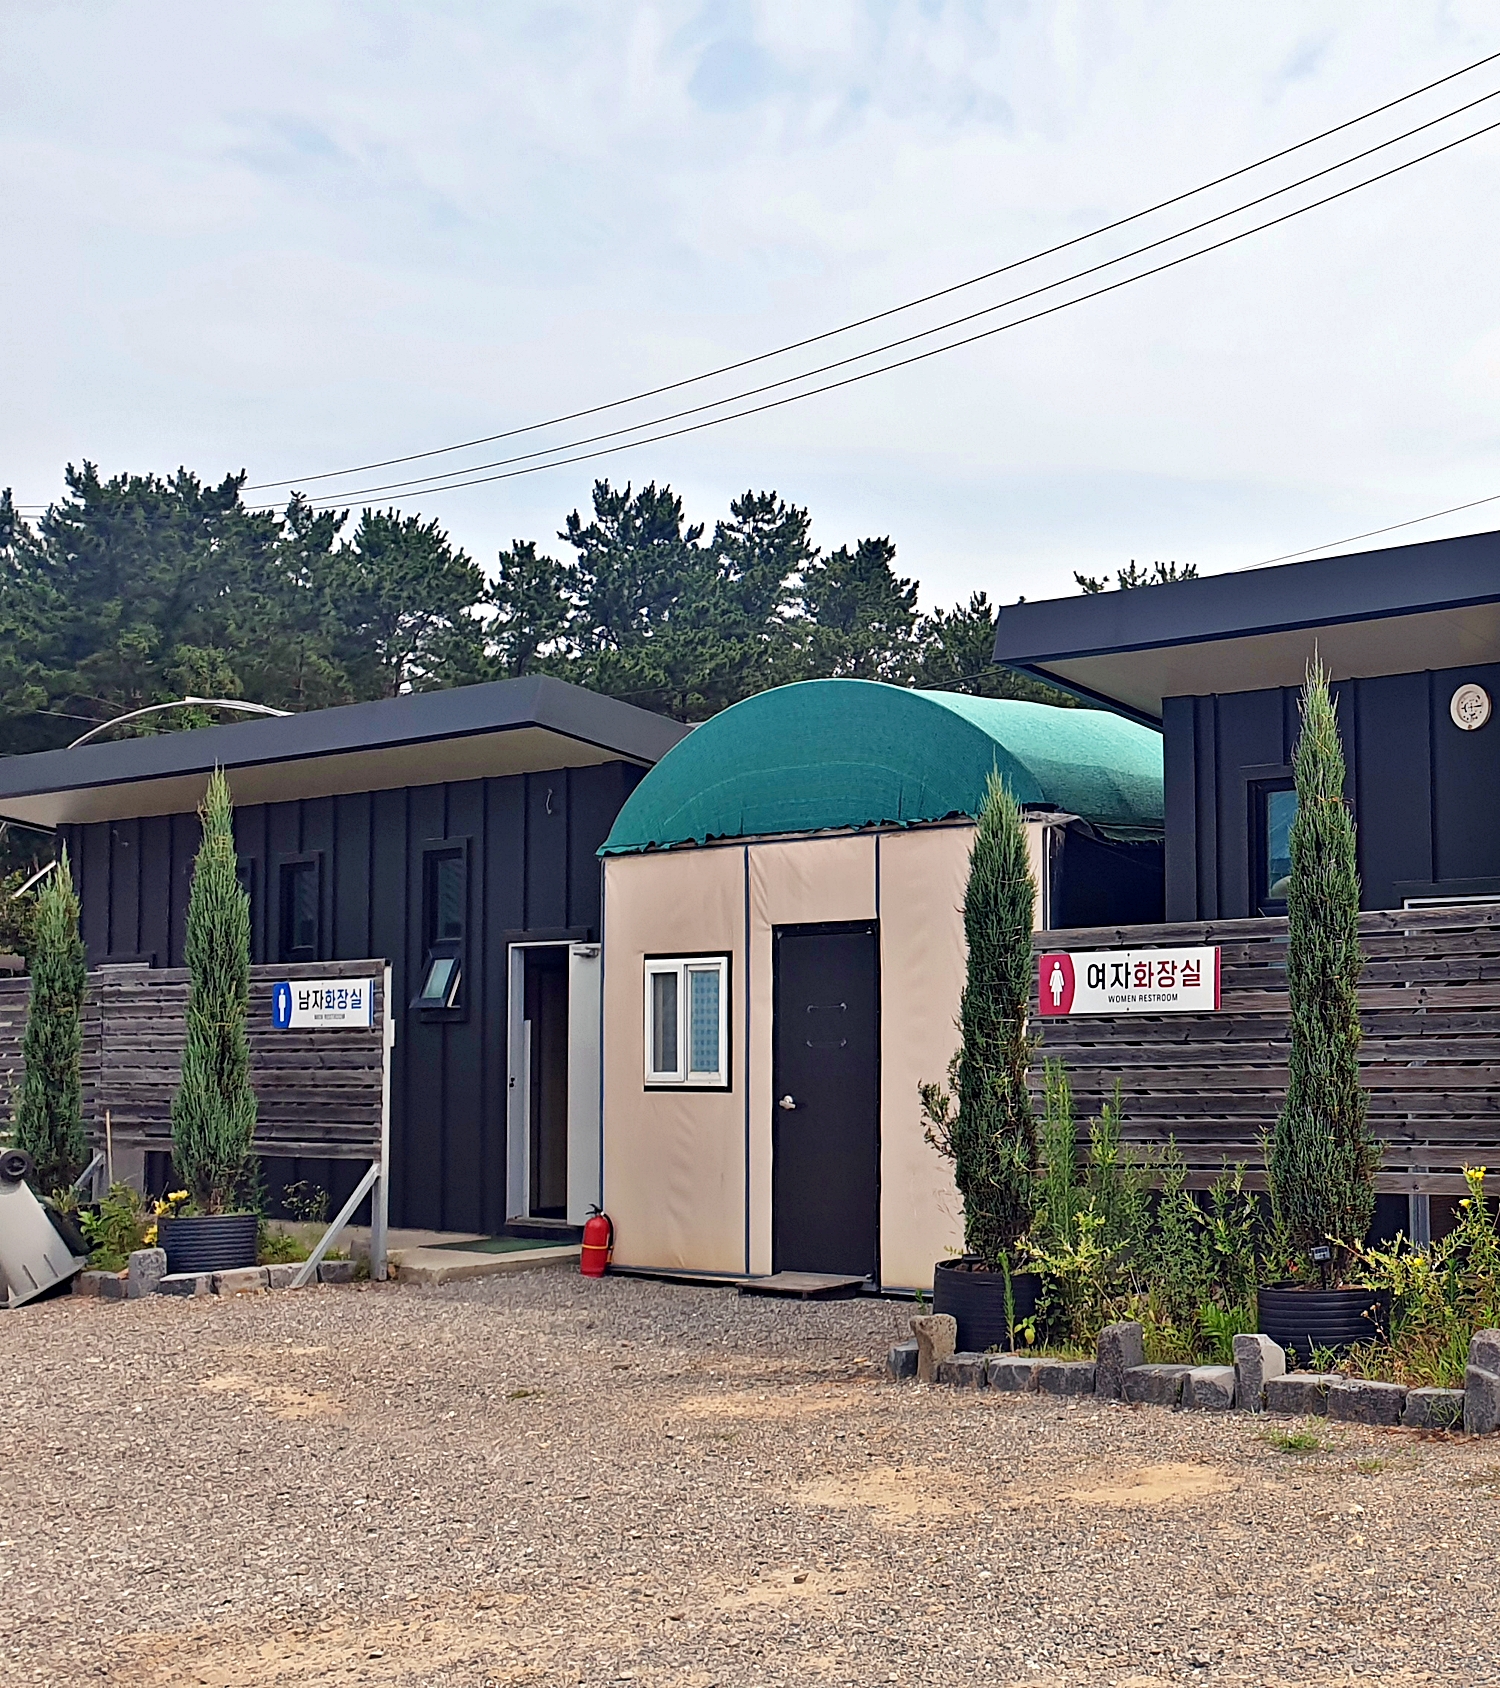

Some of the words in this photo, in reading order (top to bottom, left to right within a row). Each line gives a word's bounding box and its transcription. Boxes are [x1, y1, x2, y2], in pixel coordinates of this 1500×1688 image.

[1087, 959, 1201, 990] 여자화장실
[298, 988, 362, 1011] 남자화장실
[1108, 994, 1137, 1003] WOMEN
[1138, 993, 1179, 1003] RESTROOM
